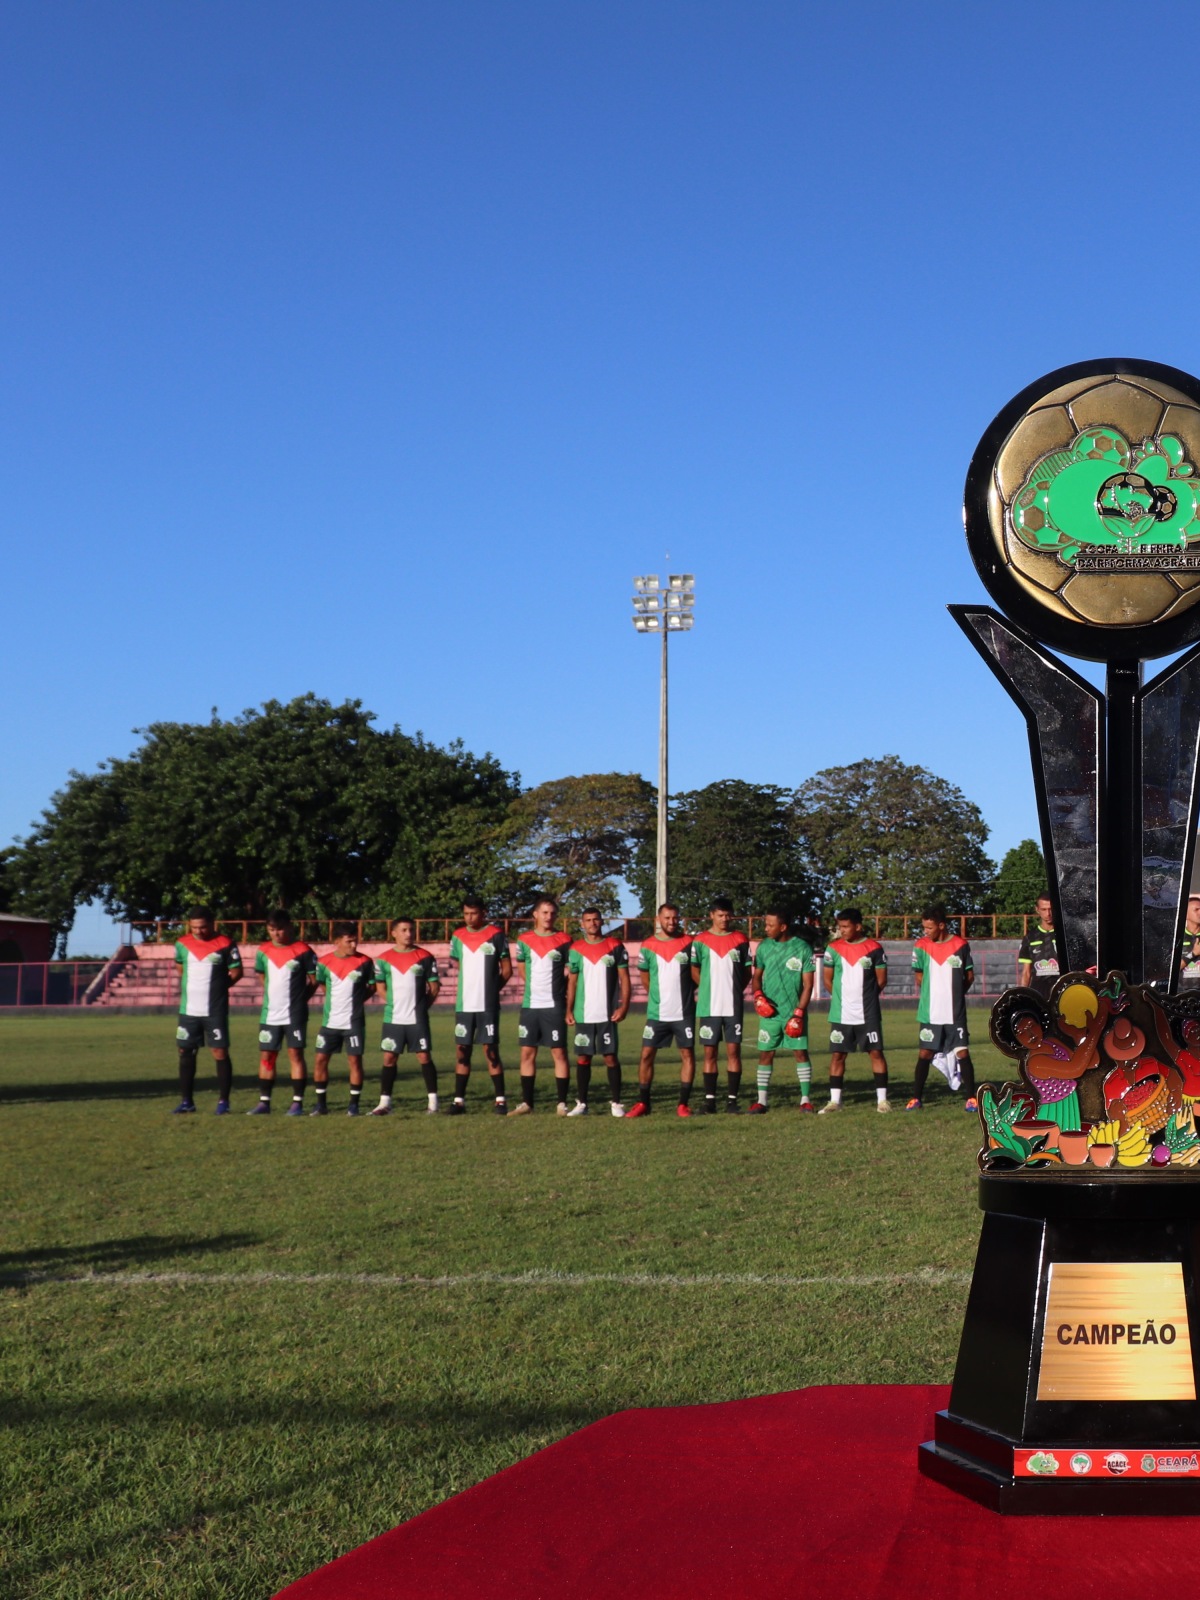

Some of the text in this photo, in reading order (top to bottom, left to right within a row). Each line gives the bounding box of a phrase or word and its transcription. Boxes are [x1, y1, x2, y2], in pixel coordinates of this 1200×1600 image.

[1088, 544, 1118, 553] COPA
[1078, 558, 1094, 568] DA
[1097, 558, 1150, 568] REFORMA
[213, 1028, 222, 1040] 3
[685, 1027, 693, 1039] 6
[734, 1024, 741, 1035] 2
[957, 1027, 964, 1039] 7
[293, 1030, 301, 1041] 4
[552, 1030, 559, 1041] 8
[603, 1033, 611, 1044] 5
[866, 1031, 878, 1043] 10
[350, 1036, 359, 1047] 11
[419, 1038, 427, 1050] 9
[1057, 1320, 1176, 1345] CAMPEÃO
[1158, 1454, 1198, 1465] CEARÁ
